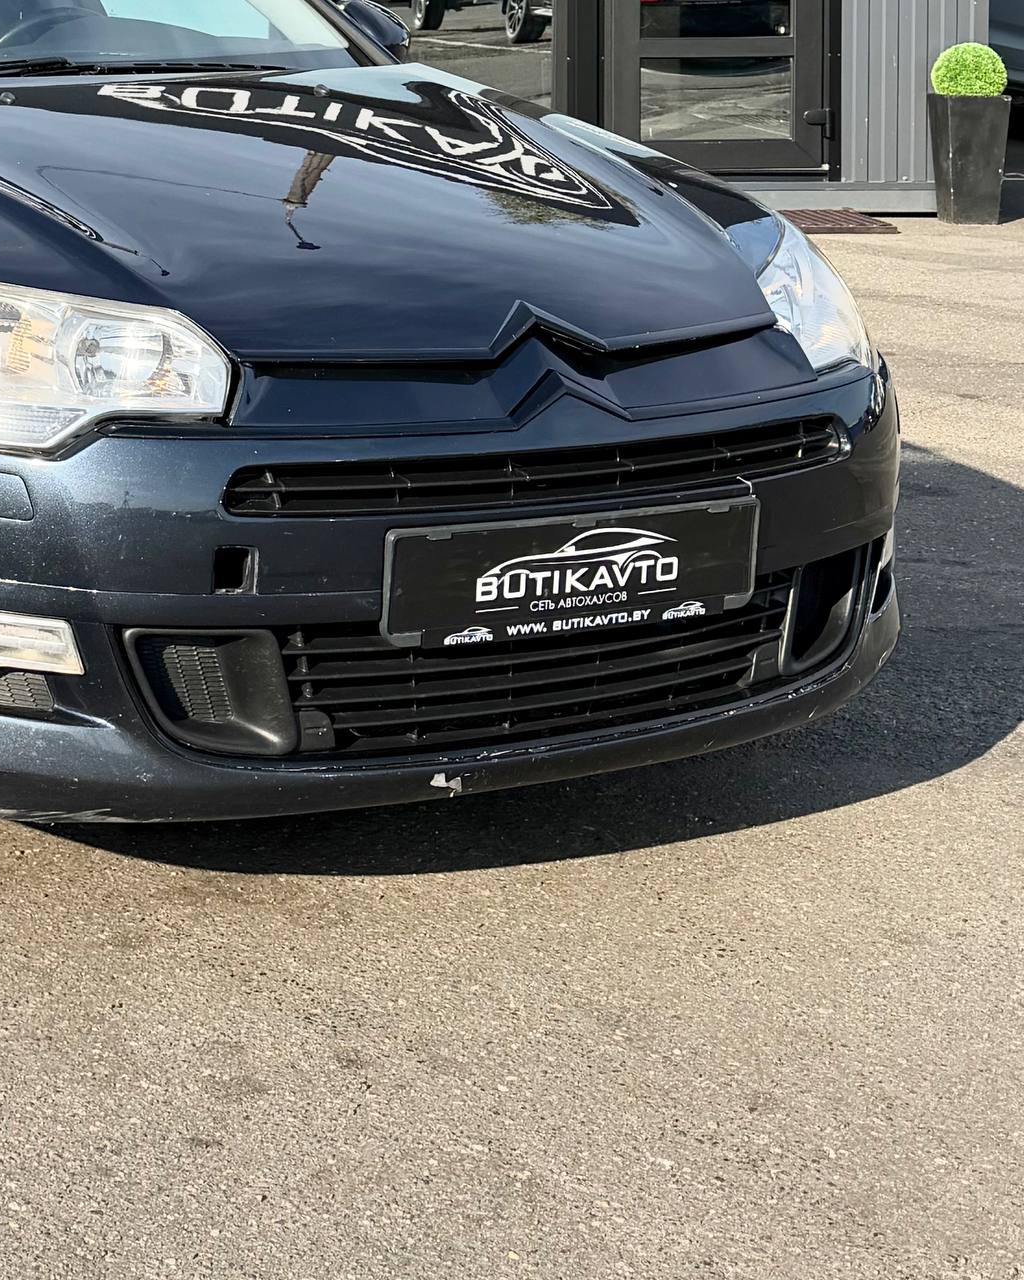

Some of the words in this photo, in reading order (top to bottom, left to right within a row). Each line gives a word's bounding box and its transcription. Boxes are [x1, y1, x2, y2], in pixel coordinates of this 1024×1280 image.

[476, 556, 679, 602] BUTIKAVTO
[530, 599, 555, 612] СЕТЬ
[557, 591, 628, 609] АВТОХАУСОВ
[507, 622, 547, 636] WWW.
[552, 609, 652, 632] BUTIKAVTO.BY
[662, 607, 706, 620] BUTIKAVTO
[443, 633, 493, 646] BUTIKAVTO
